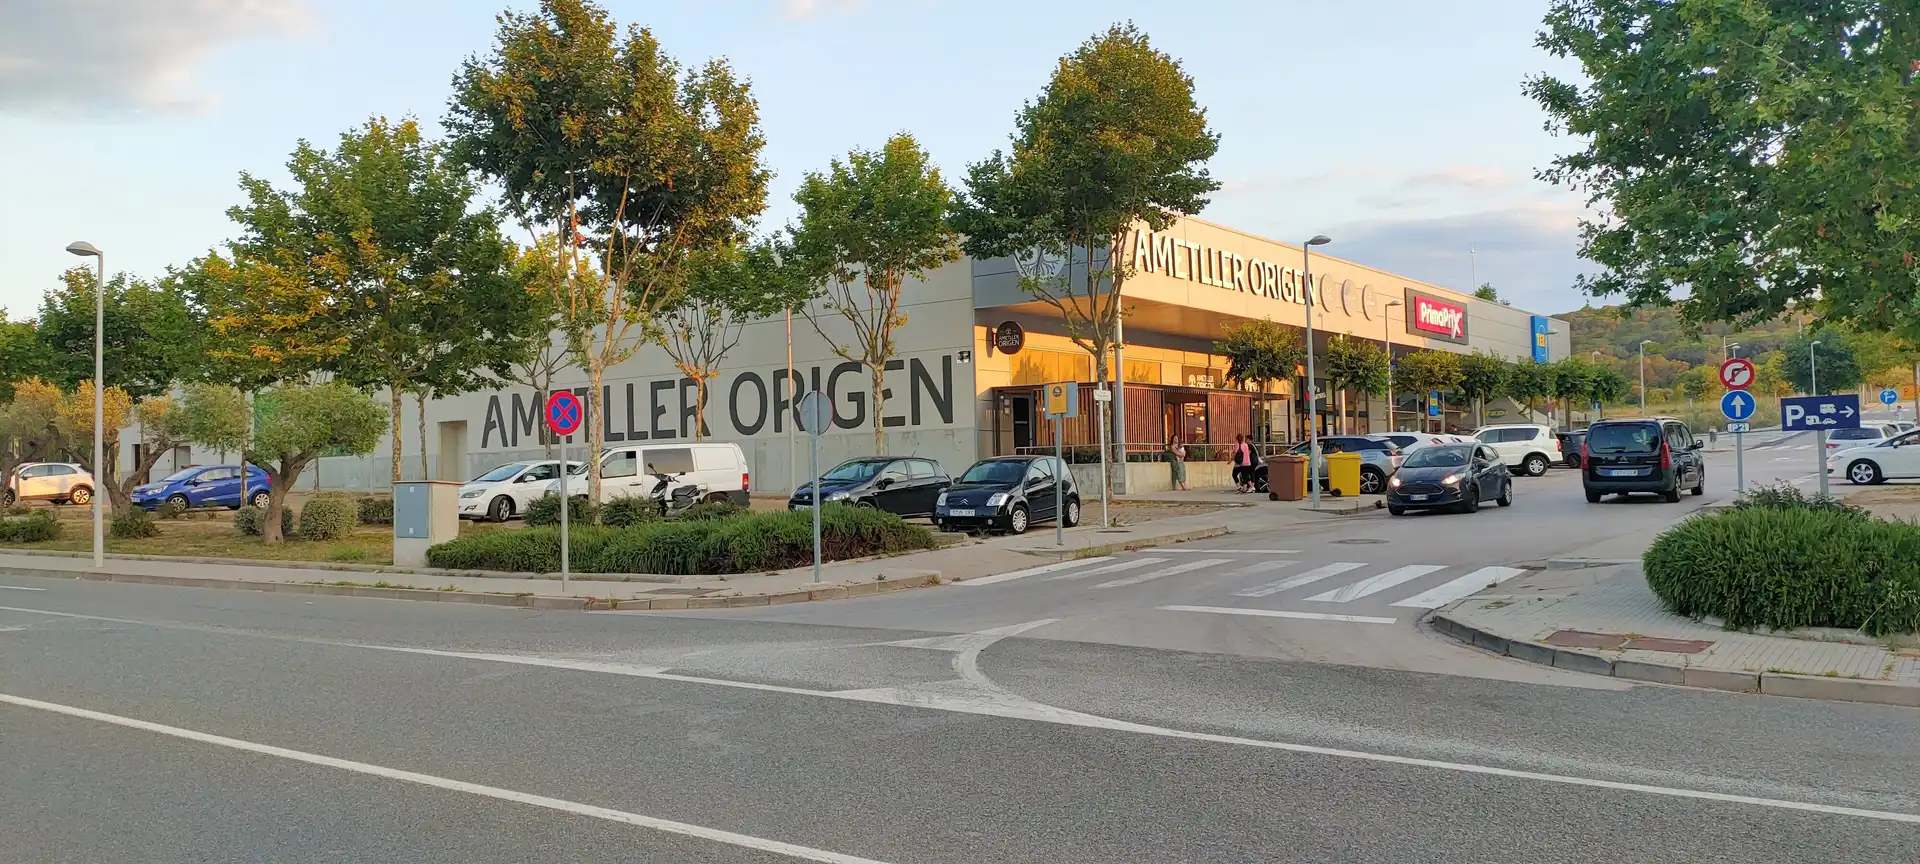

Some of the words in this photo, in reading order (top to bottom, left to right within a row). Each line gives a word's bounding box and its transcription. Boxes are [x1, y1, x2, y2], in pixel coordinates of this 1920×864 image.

[1133, 228, 1247, 292] AMETLLER
[1248, 257, 1317, 307] ORIGEN
[1785, 405, 1805, 427] P
